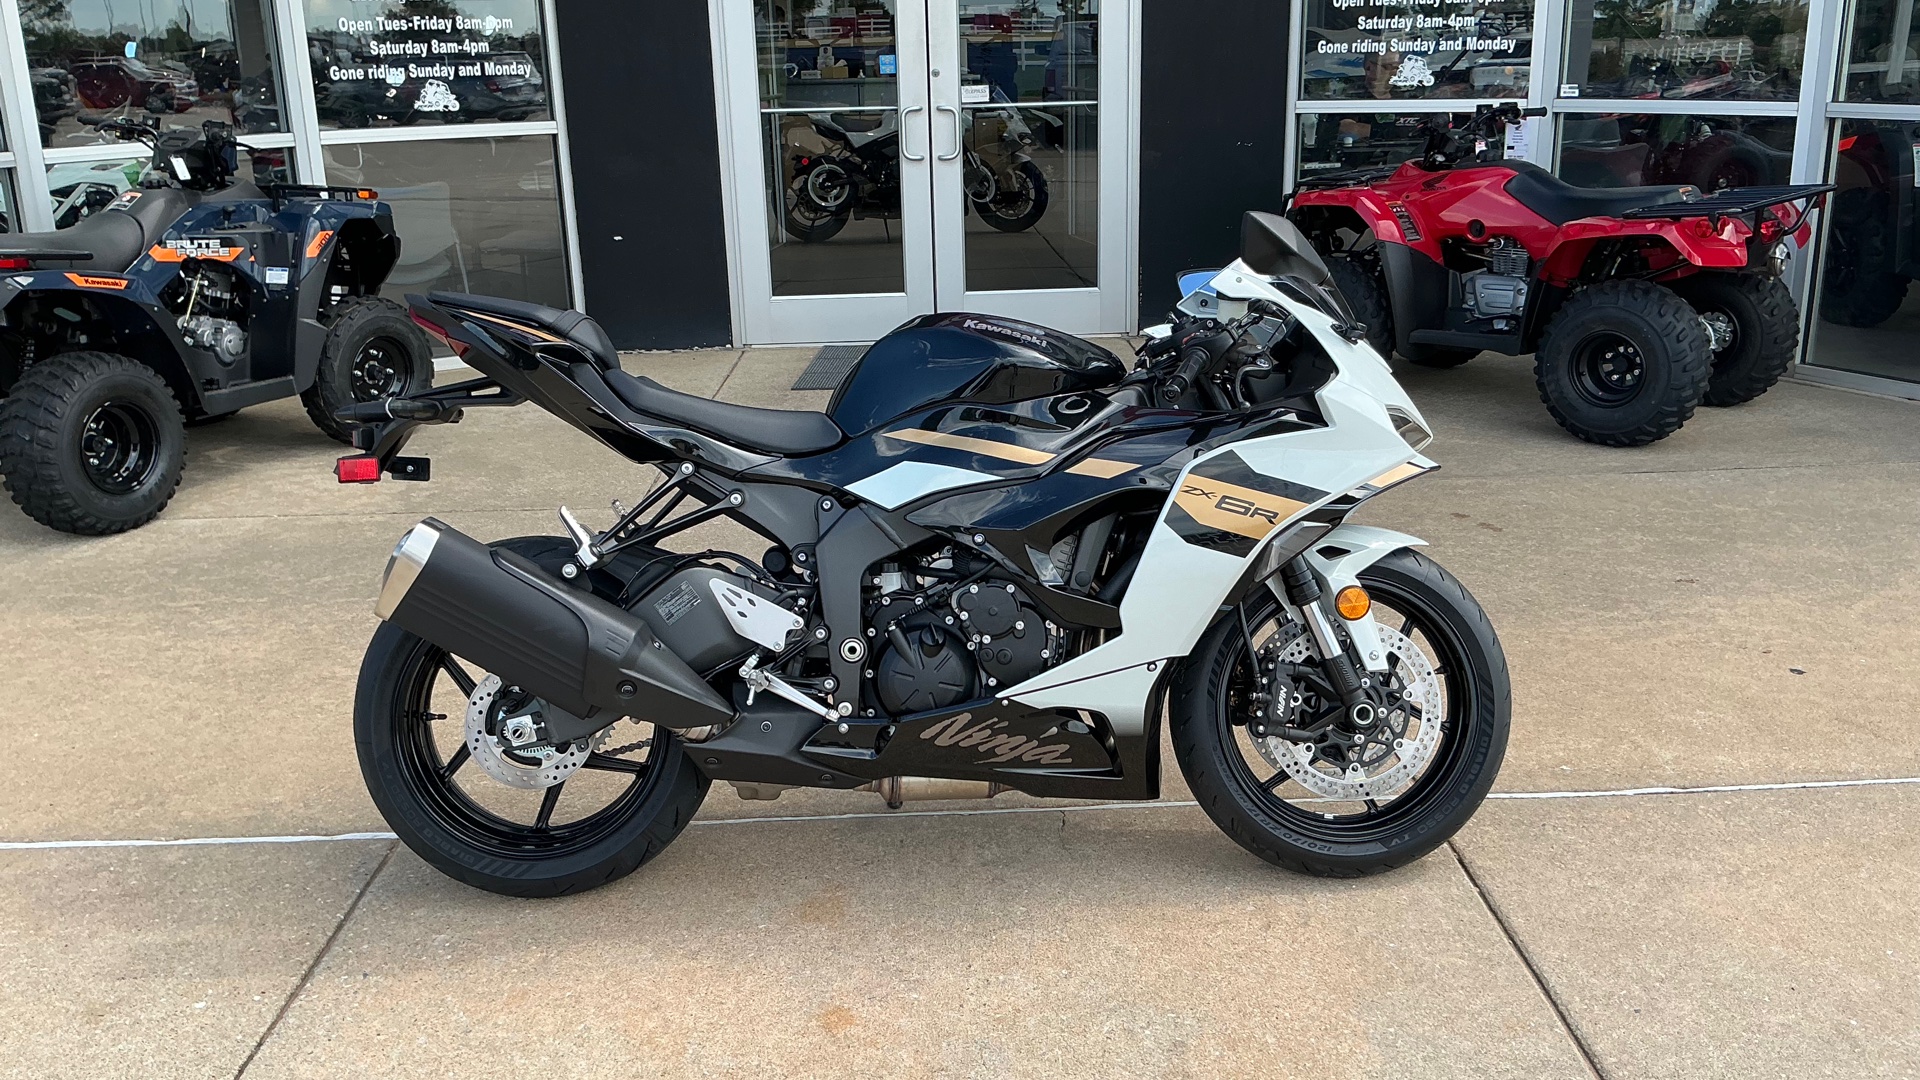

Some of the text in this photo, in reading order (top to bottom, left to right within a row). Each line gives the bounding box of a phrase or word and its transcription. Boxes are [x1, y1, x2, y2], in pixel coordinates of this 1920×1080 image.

[338, 17, 373, 35] Open
[376, 15, 453, 34] Tues-Friday
[1357, 13, 1475, 31] Saturday 8am-4pm
[370, 39, 490, 58] Saturday 8am-4pm
[1317, 36, 1517, 56] Gone riding Sunday and Monday
[329, 65, 364, 81] Gone
[408, 62, 455, 81] Sunday
[458, 62, 482, 77] and
[484, 61, 531, 79] Monday
[165, 239, 221, 249] BRUTE
[315, 232, 330, 250] 300
[176, 247, 230, 257] FORCE
[83, 277, 123, 288] Kawasaki
[963, 319, 1047, 348] Kawasaki
[919, 712, 1073, 766] Ninja
